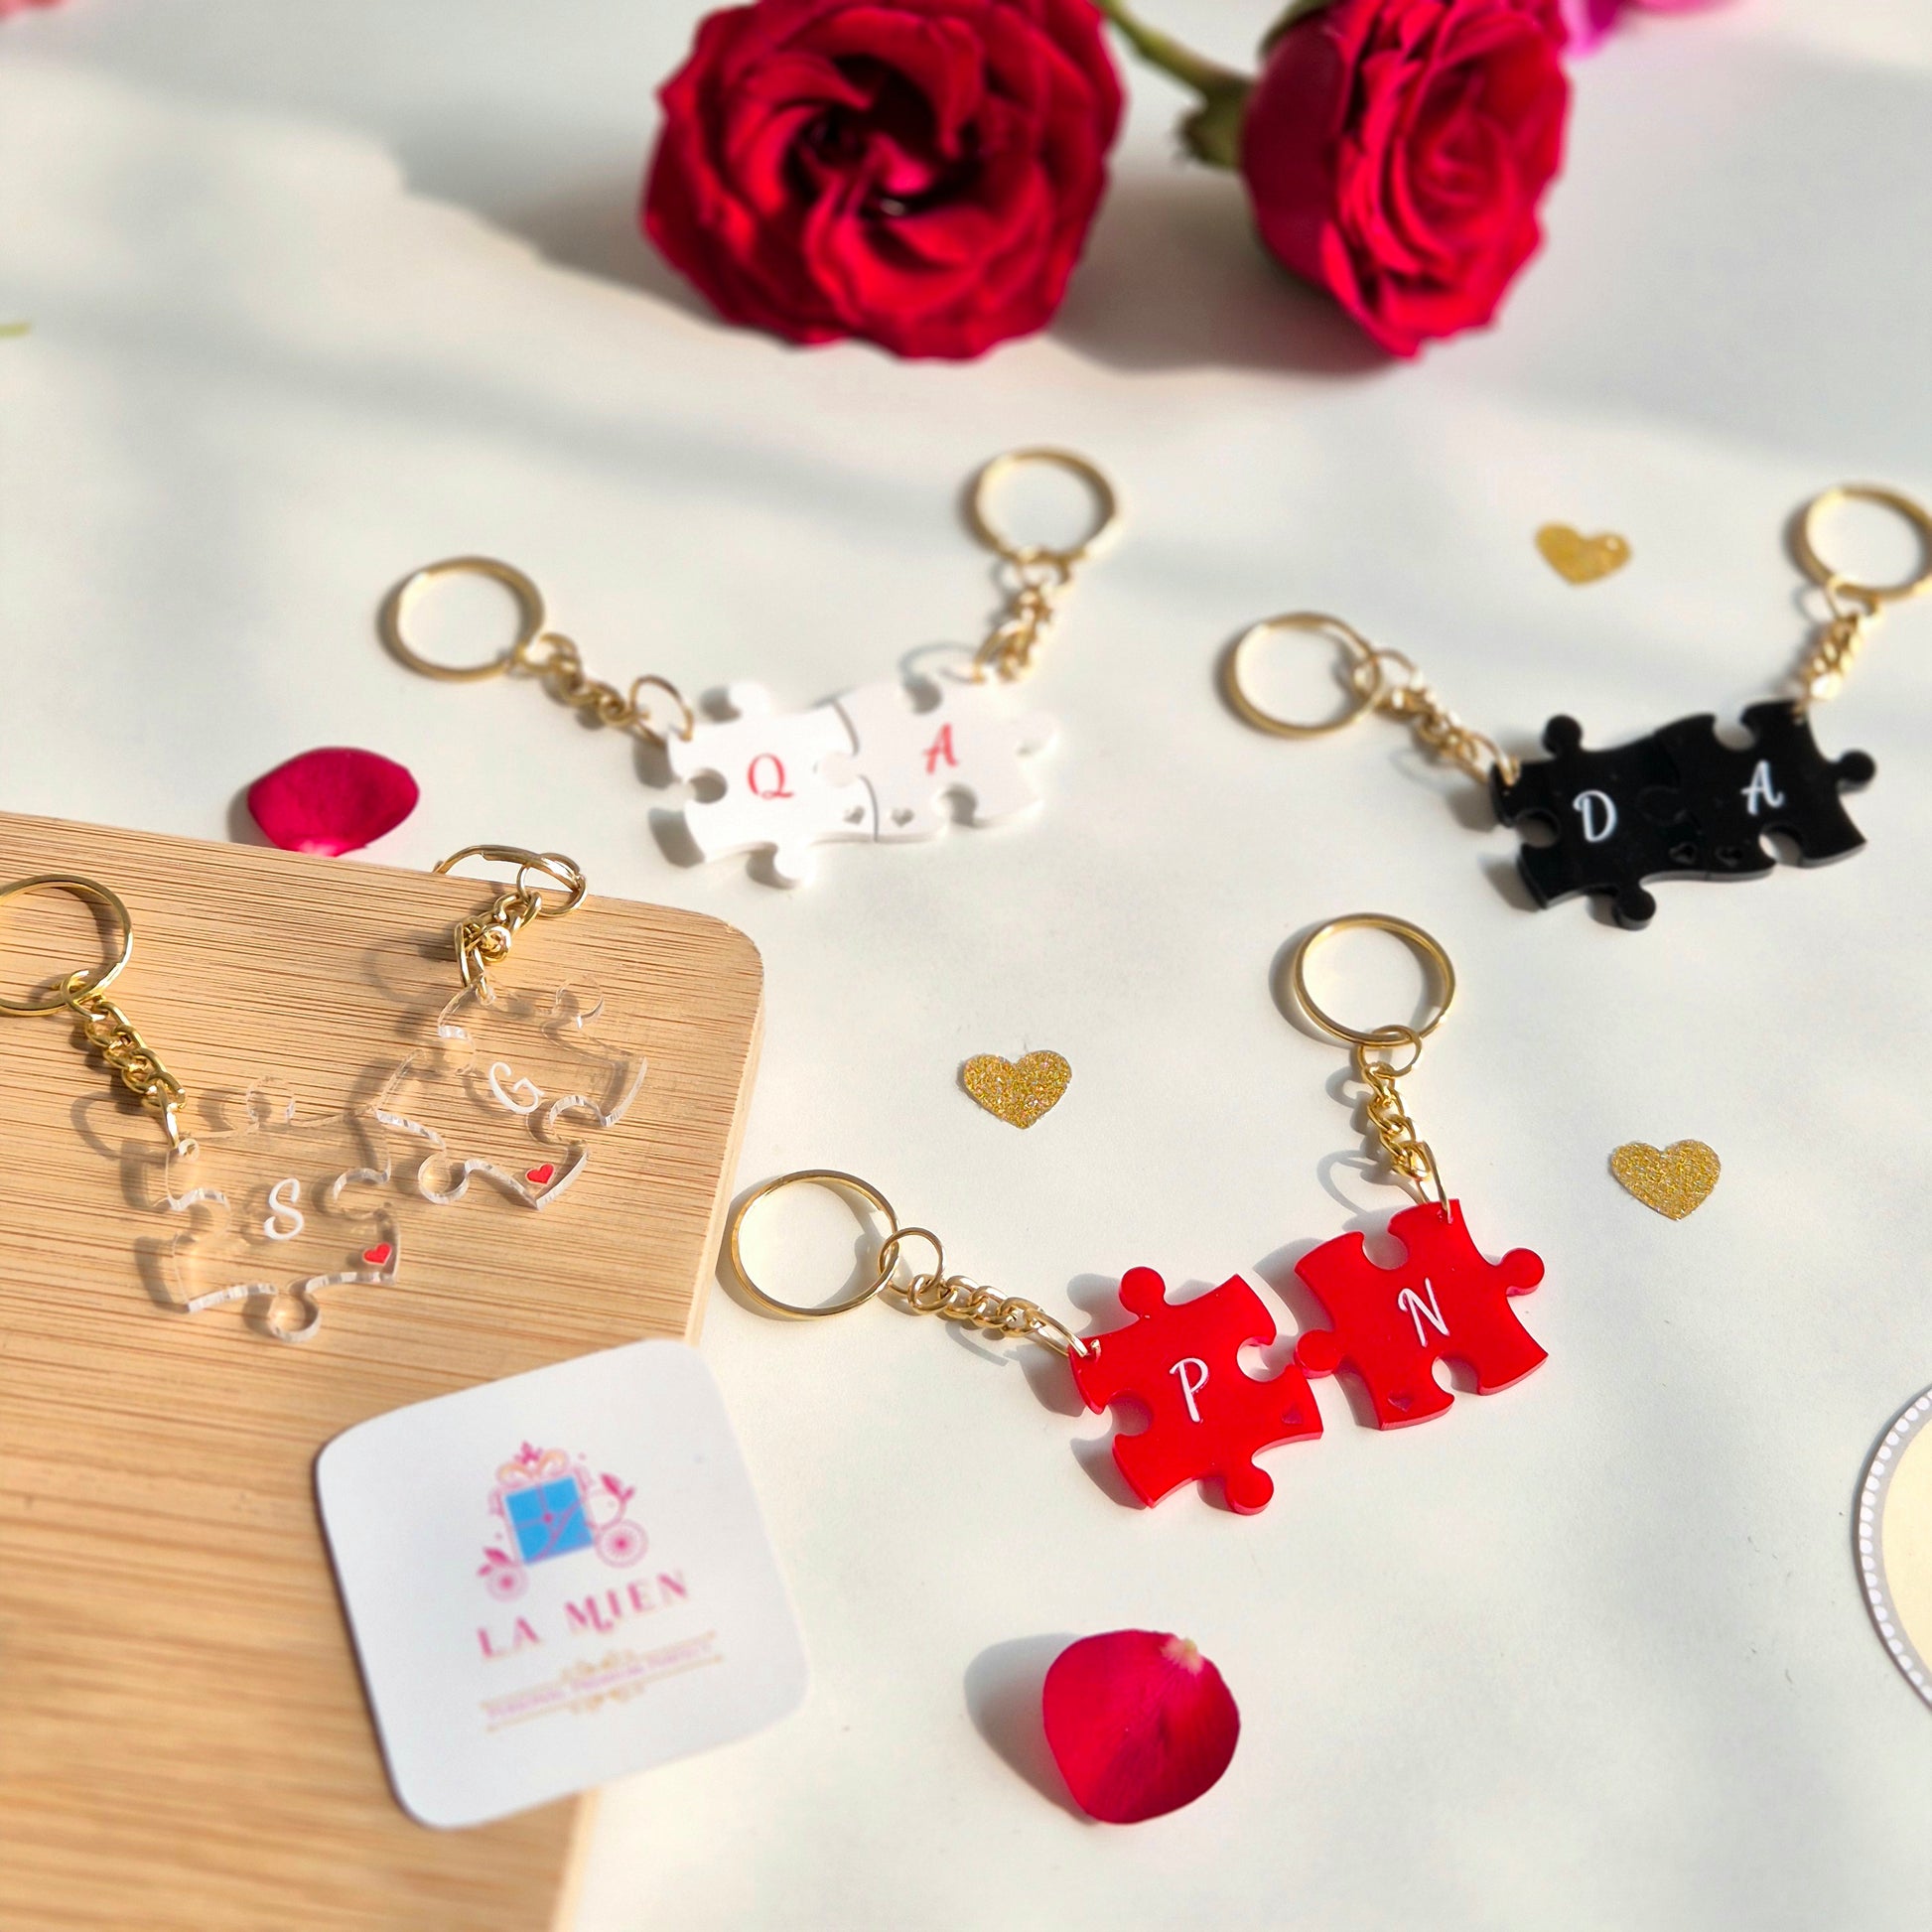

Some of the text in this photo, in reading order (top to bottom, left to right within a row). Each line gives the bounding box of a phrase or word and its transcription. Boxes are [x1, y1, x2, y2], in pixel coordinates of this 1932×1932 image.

[747, 753, 793, 799] Q
[923, 723, 958, 773] A
[1741, 759, 1784, 815] A
[1574, 790, 1617, 842] D
[488, 1061, 544, 1114] G
[264, 1177, 304, 1240] S
[1398, 1278, 1450, 1346] N
[1170, 1357, 1209, 1423] P
[478, 1569, 688, 1663] LA MIEN
